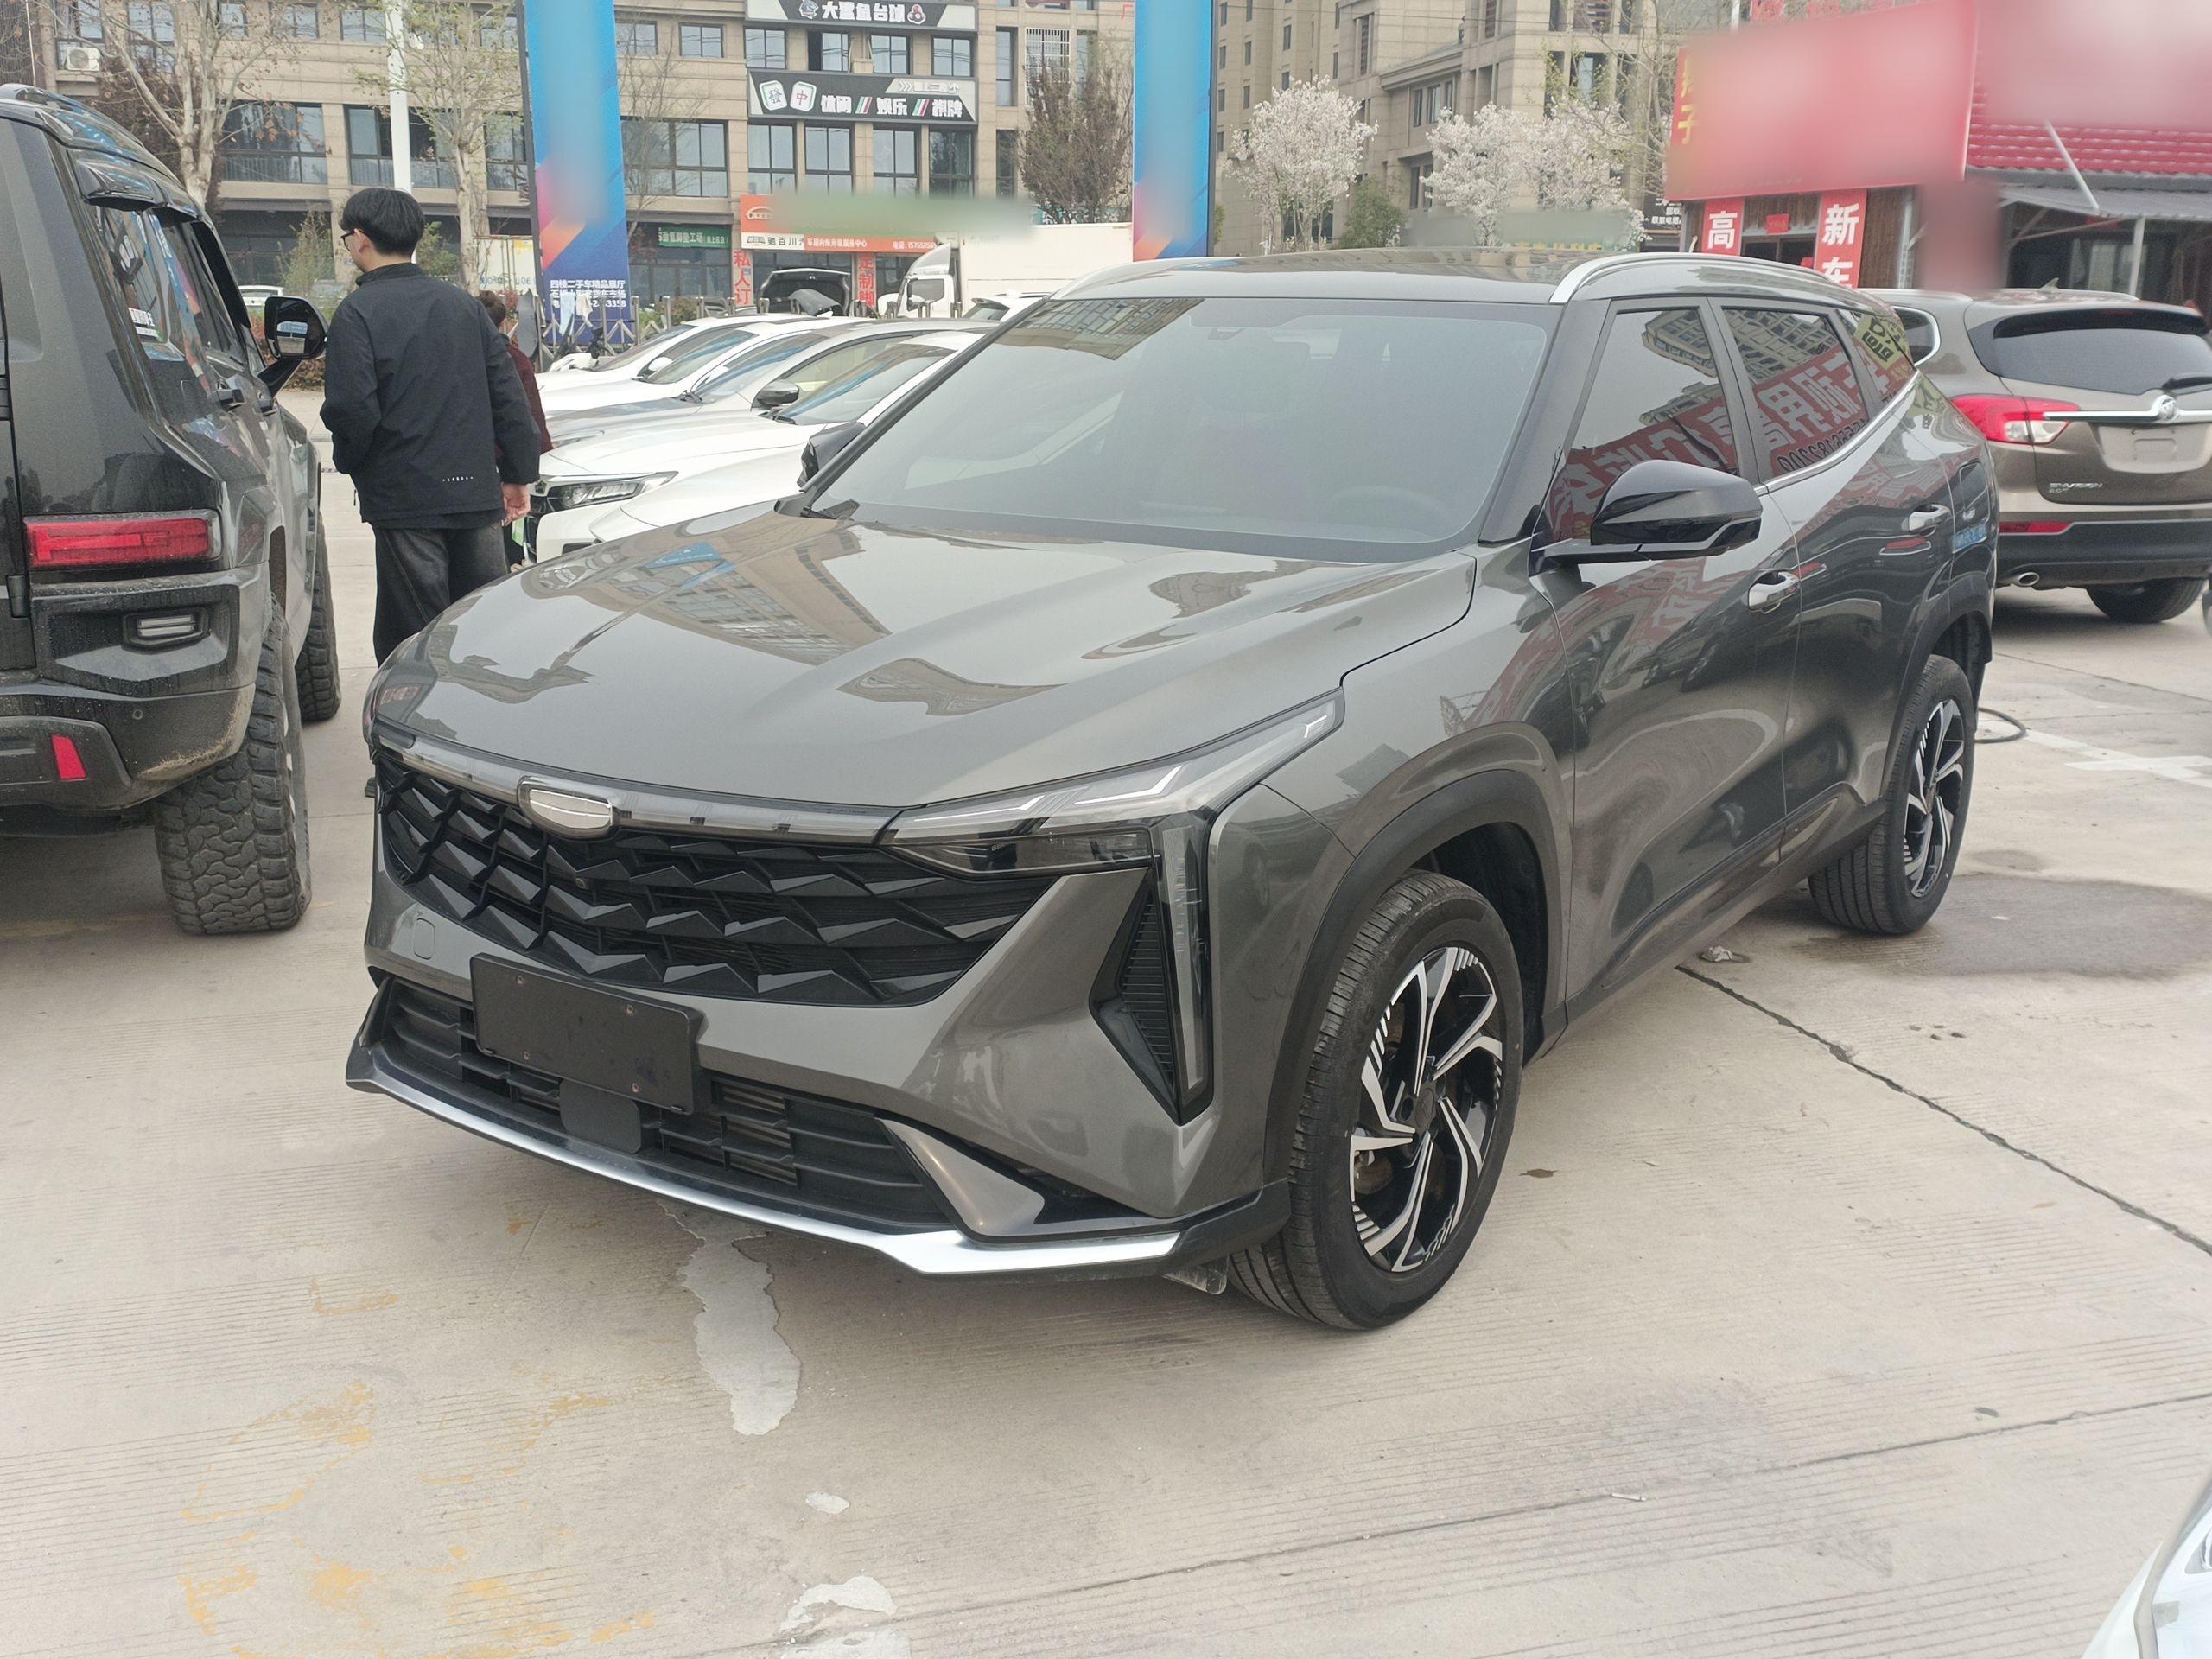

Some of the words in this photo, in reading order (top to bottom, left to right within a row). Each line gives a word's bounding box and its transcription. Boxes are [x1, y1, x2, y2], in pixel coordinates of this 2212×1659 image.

[1707, 210, 1738, 249] 高
[733, 250, 751, 305] 私人订
